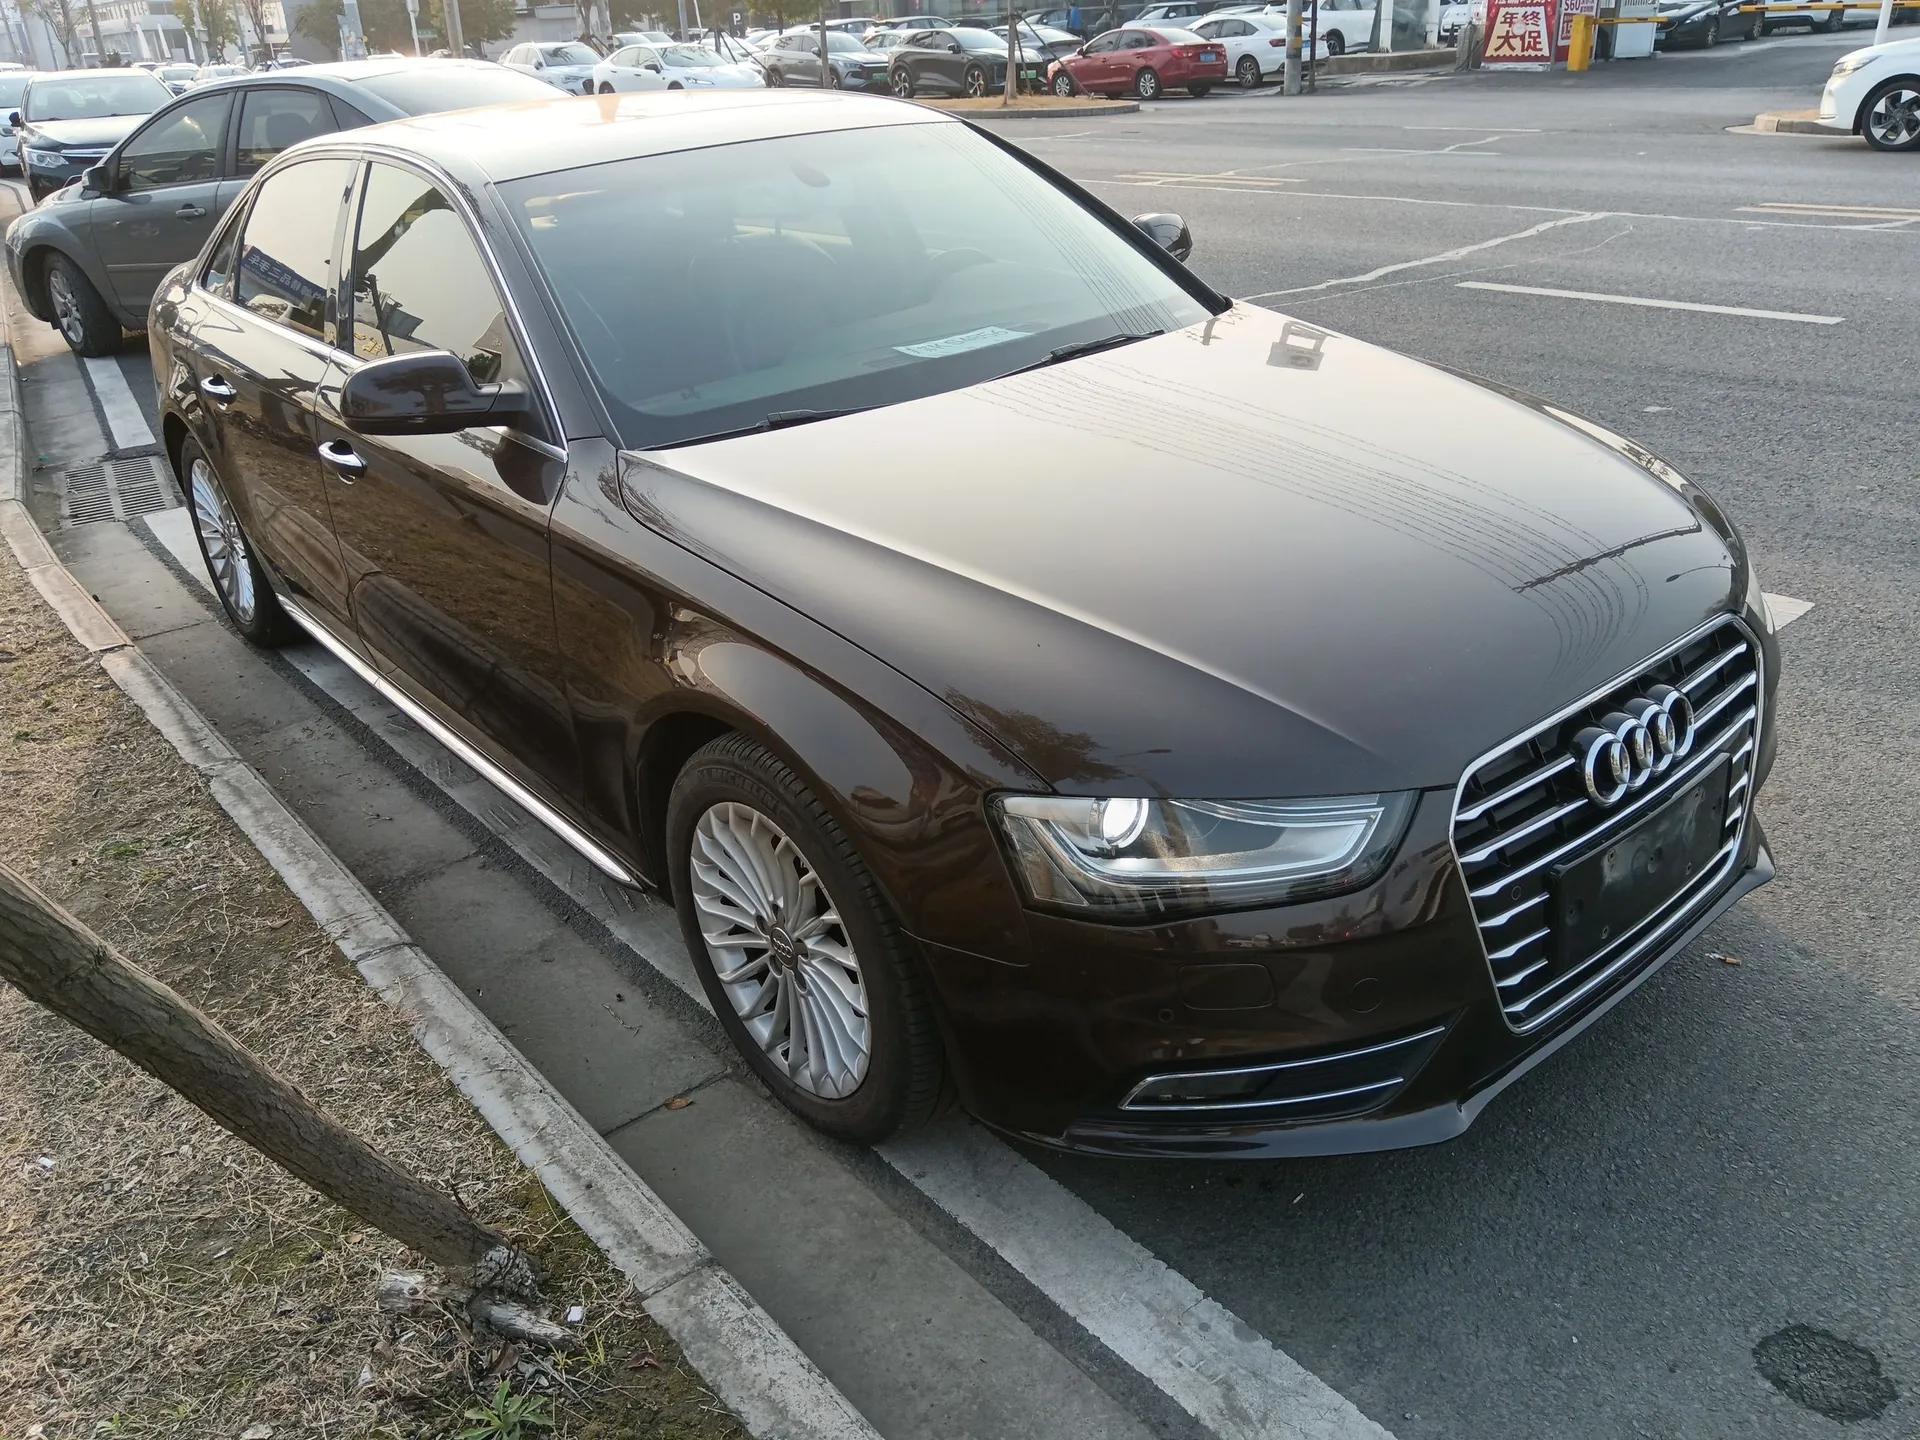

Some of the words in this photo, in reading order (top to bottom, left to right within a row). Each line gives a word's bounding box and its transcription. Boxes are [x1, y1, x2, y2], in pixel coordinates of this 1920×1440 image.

[733, 13, 741, 25] P
[1500, 11, 1541, 28] 年终
[1494, 30, 1543, 52] 大促
